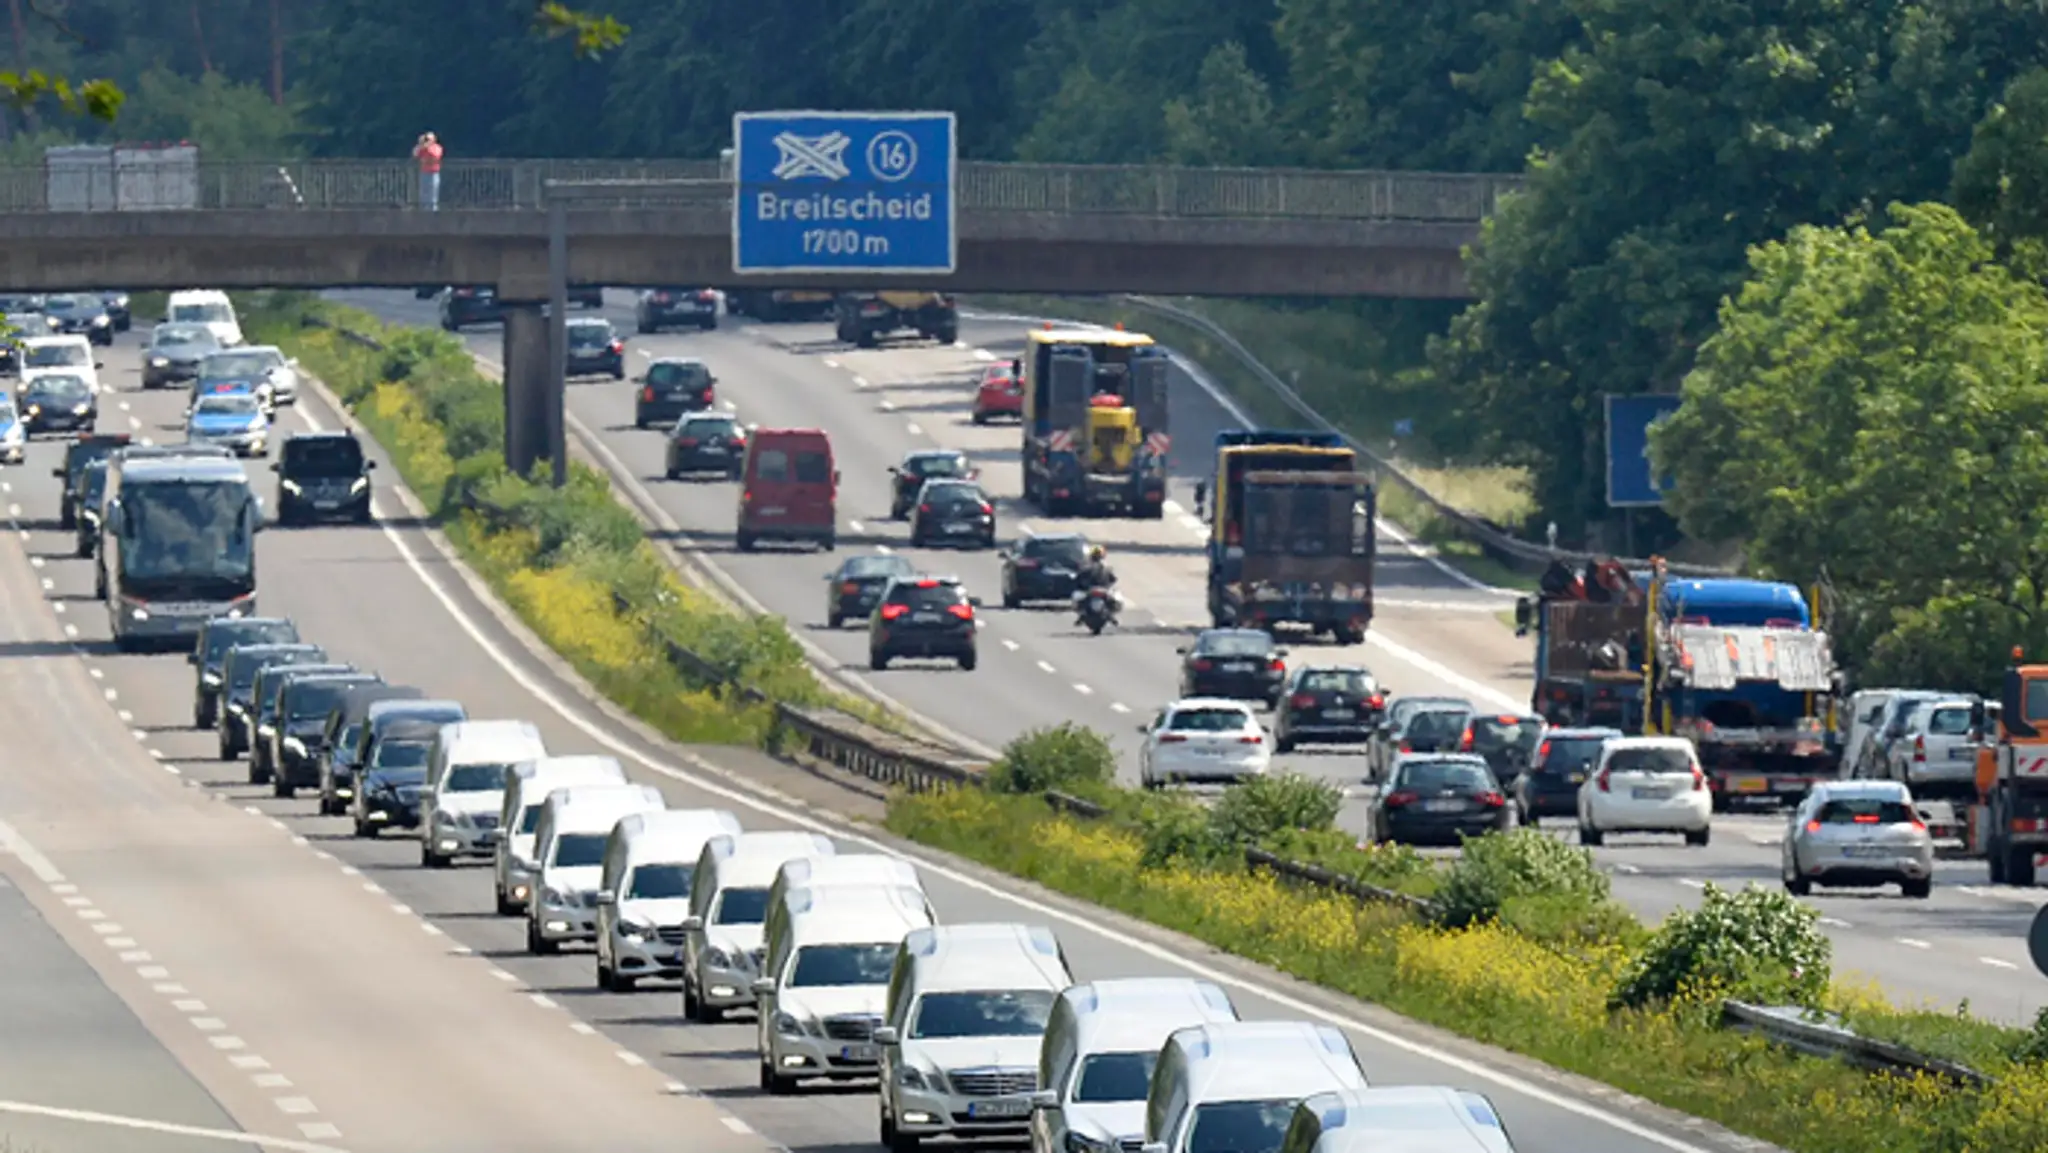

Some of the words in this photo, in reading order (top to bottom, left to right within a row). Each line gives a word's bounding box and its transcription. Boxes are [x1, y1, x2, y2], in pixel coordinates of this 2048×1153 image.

[878, 140, 905, 170] 16
[757, 191, 932, 220] Breitscheid
[803, 229, 859, 254] 1700
[863, 234, 889, 254] m
